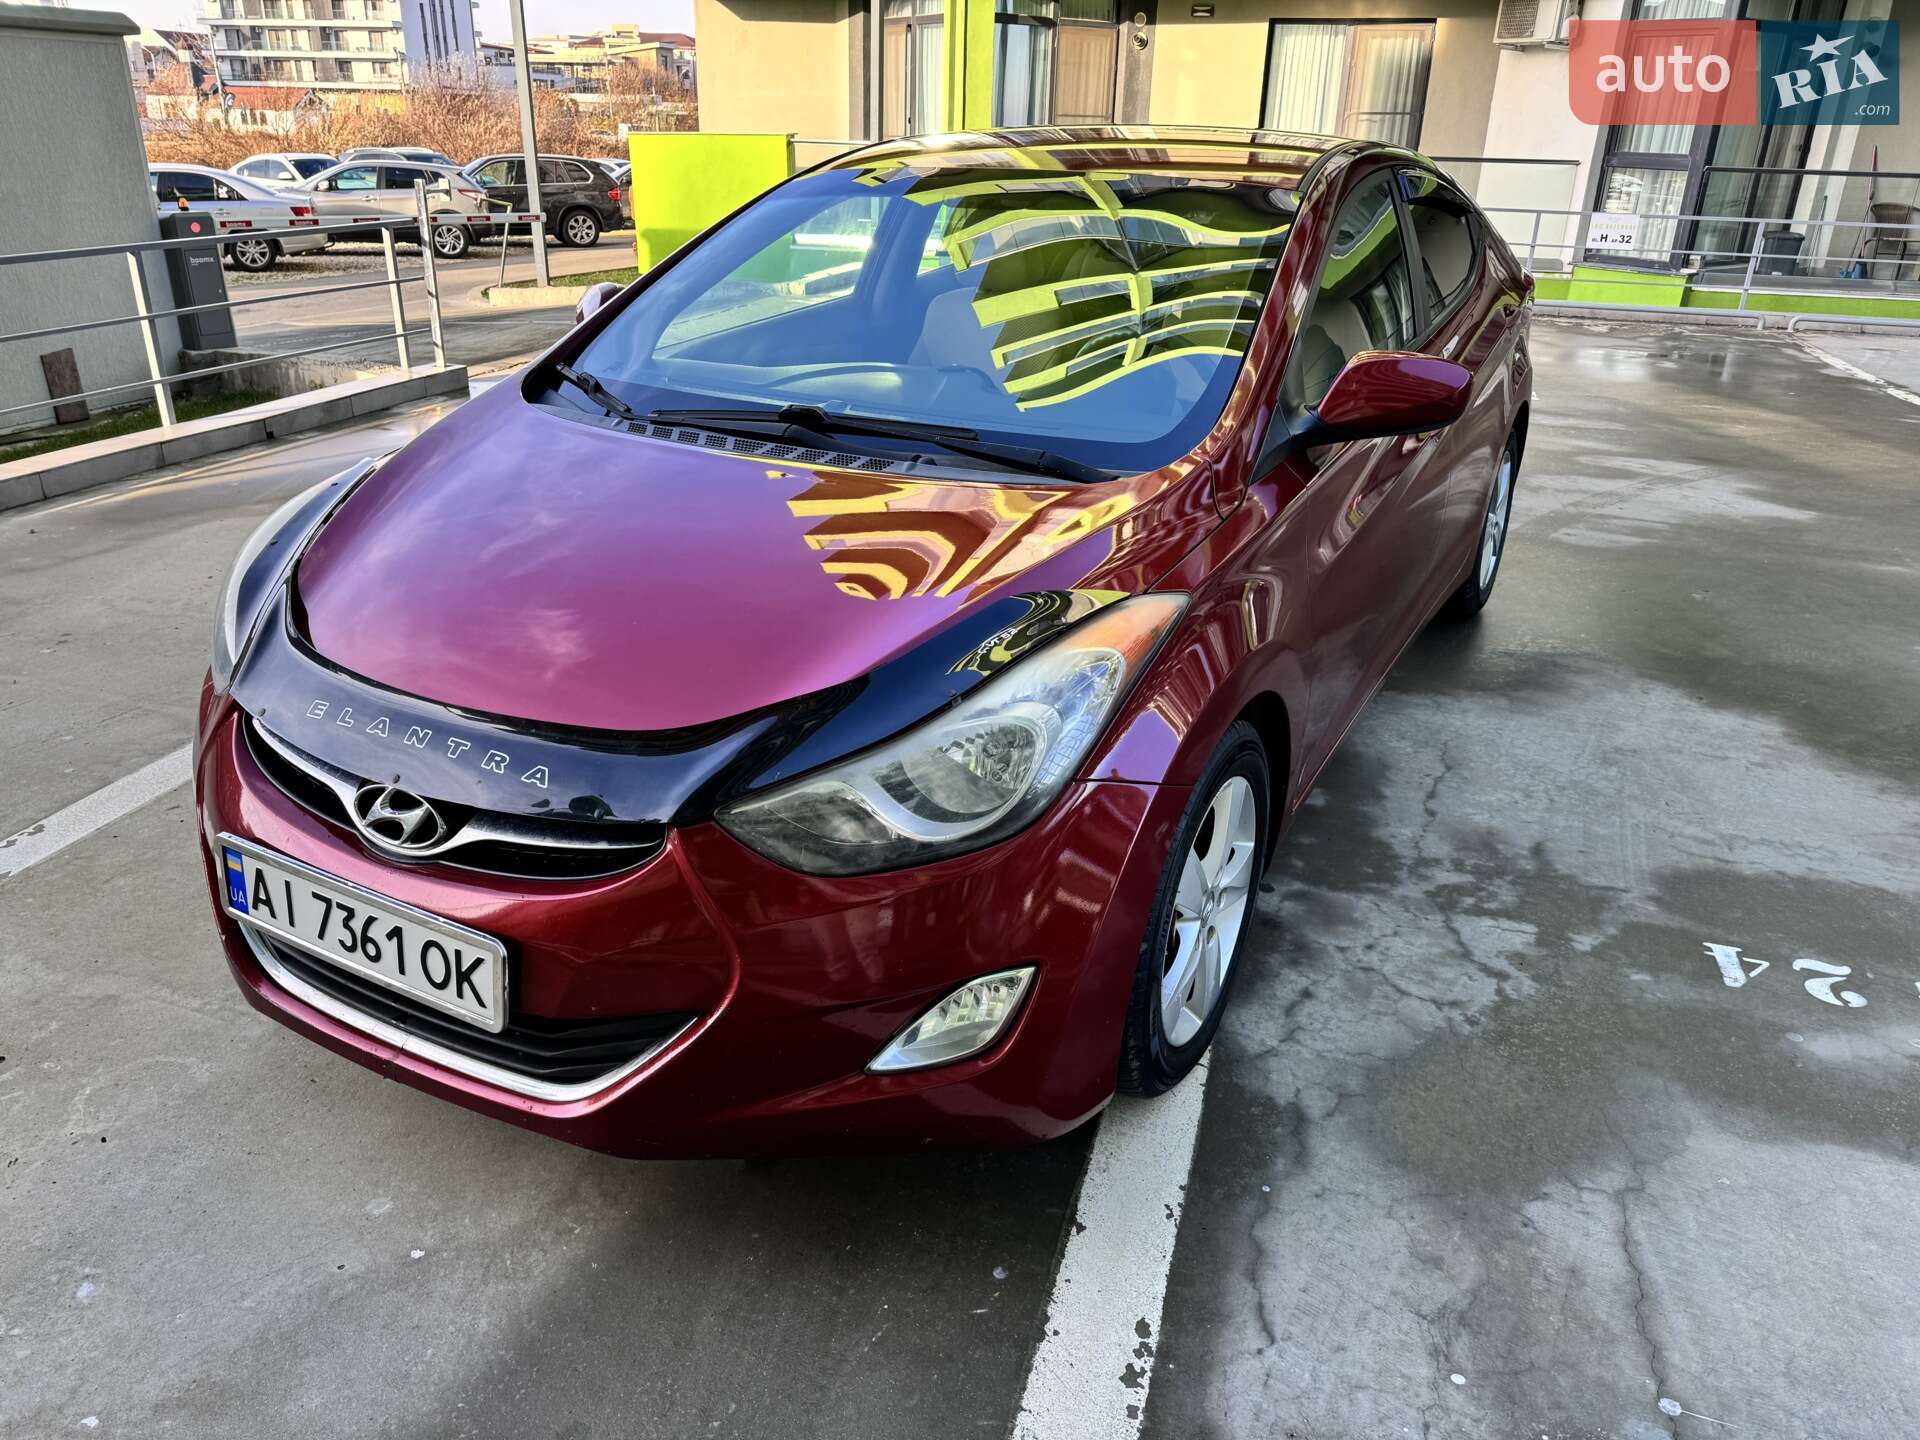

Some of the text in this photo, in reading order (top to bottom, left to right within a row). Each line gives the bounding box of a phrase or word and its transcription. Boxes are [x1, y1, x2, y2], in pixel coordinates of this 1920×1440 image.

[1600, 234, 1608, 243] H
[1619, 235, 1632, 244] 32
[306, 700, 549, 788] ELANTRA
[229, 886, 247, 905] UA
[252, 867, 487, 1009] AI 7361 OK
